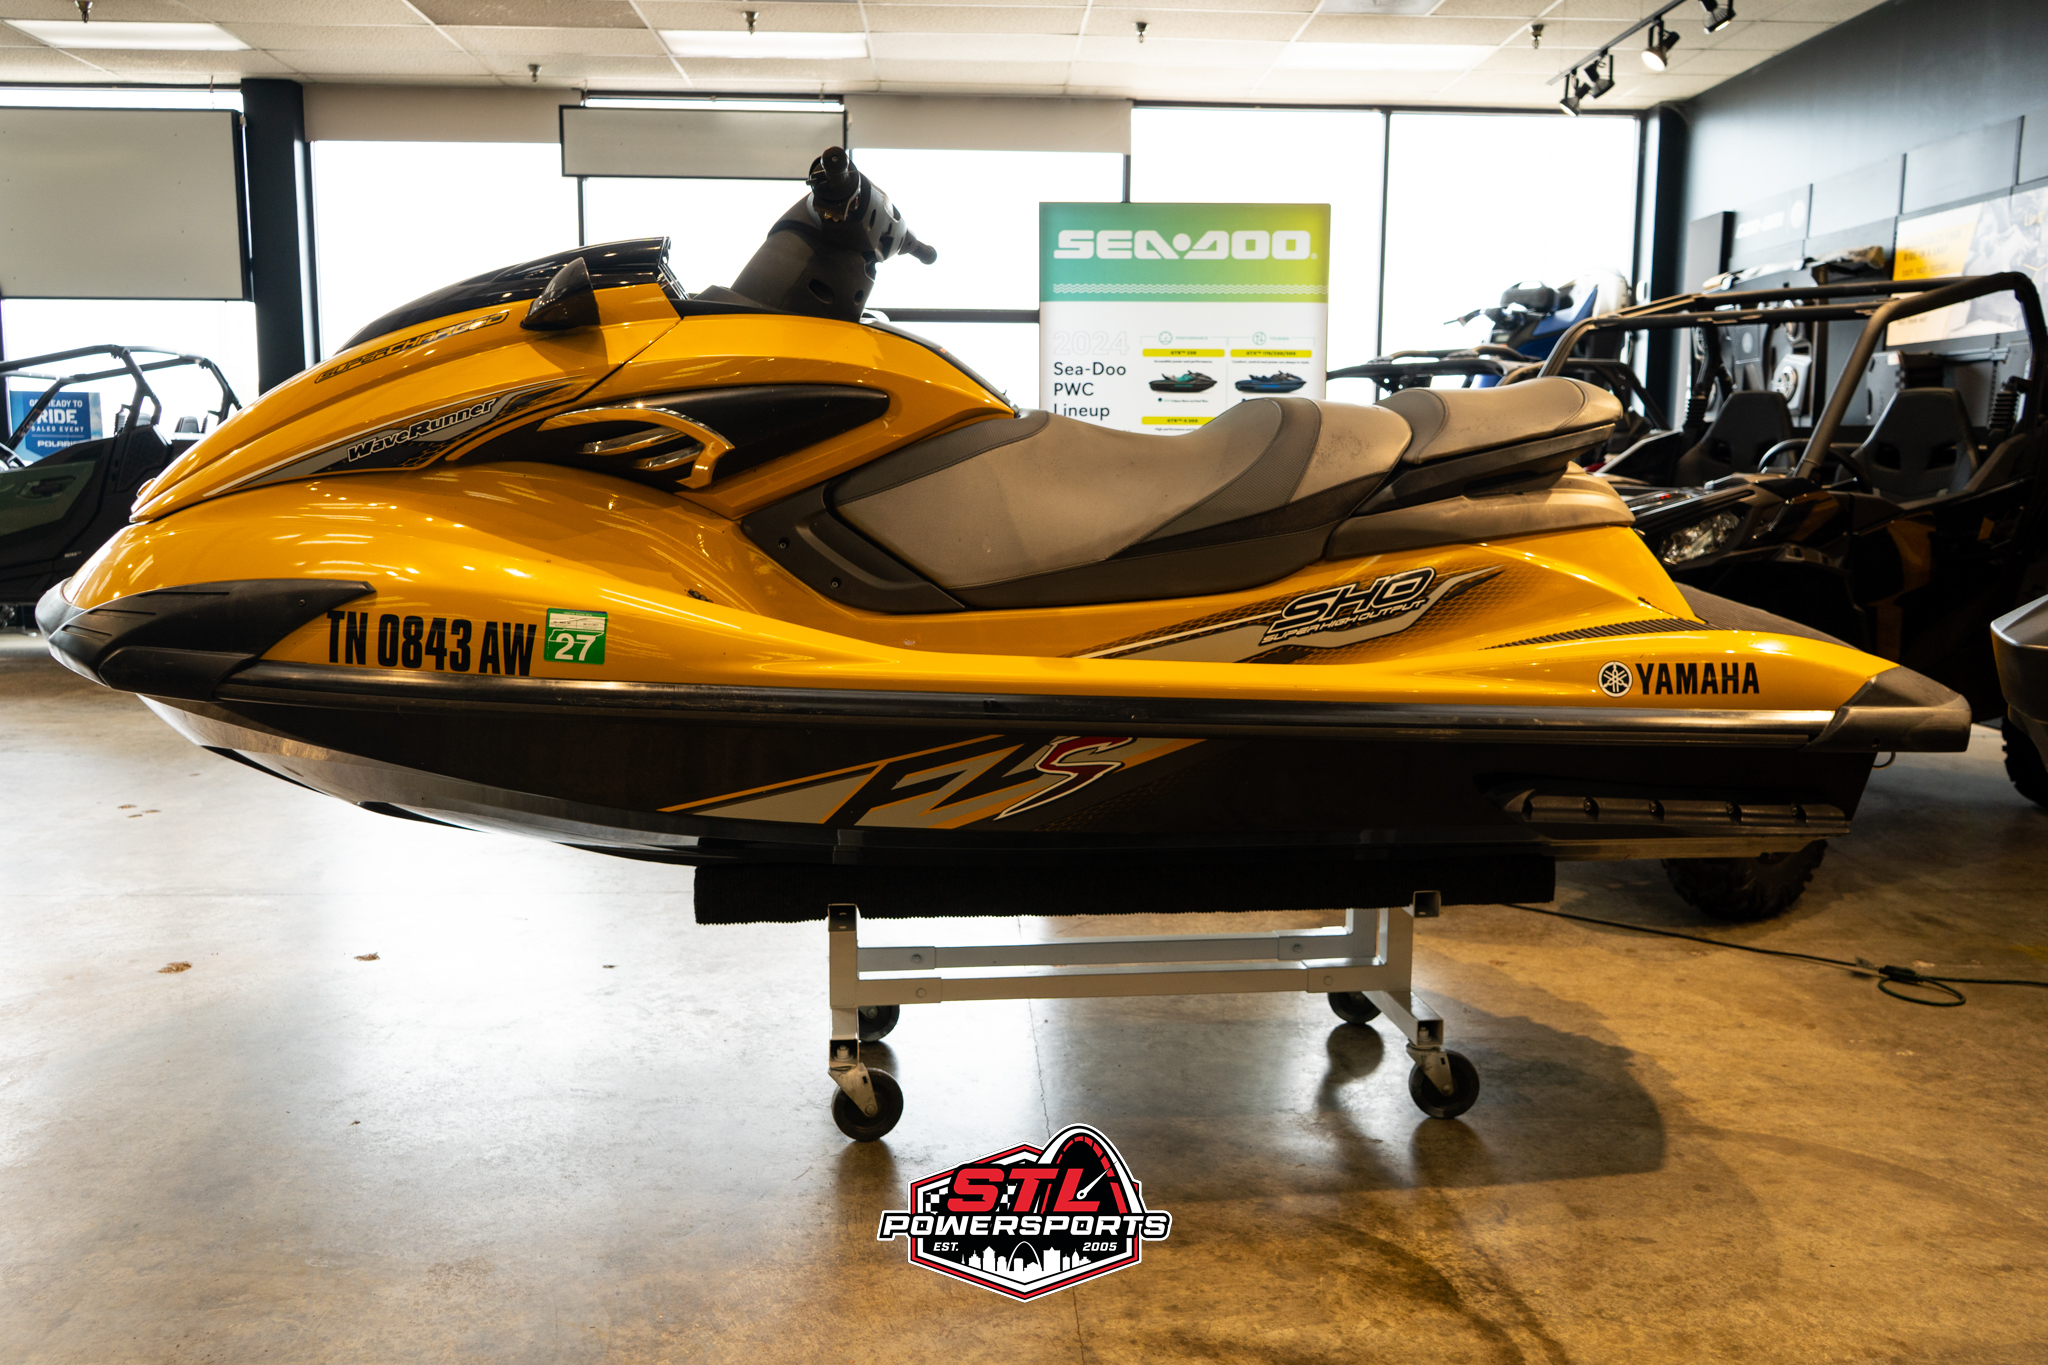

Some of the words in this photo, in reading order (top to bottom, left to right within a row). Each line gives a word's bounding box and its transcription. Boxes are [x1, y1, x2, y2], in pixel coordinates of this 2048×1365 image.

[314, 310, 510, 384] SUPERCHARGED
[1053, 330, 1130, 356] 2024
[1053, 361, 1127, 376] Sea-Doo
[1053, 382, 1095, 396] PWC
[36, 408, 78, 425] RIDE
[47, 399, 71, 408] EADY
[72, 400, 83, 408] TO
[1053, 403, 1111, 421] Lineup
[31, 425, 57, 433] SALES
[59, 425, 85, 433] EVENT
[347, 397, 500, 462] WaveRunner
[37, 440, 78, 448] POLARI
[1267, 566, 1436, 635] SHO
[1260, 624, 1320, 644] SUPER
[1319, 615, 1361, 631] HIGH
[1359, 599, 1427, 621] OUTPUT
[327, 610, 369, 666] TN
[377, 613, 473, 673] 0843
[478, 621, 538, 677] AW
[554, 632, 597, 662] 27
[1635, 662, 1760, 695] YAMAHA
